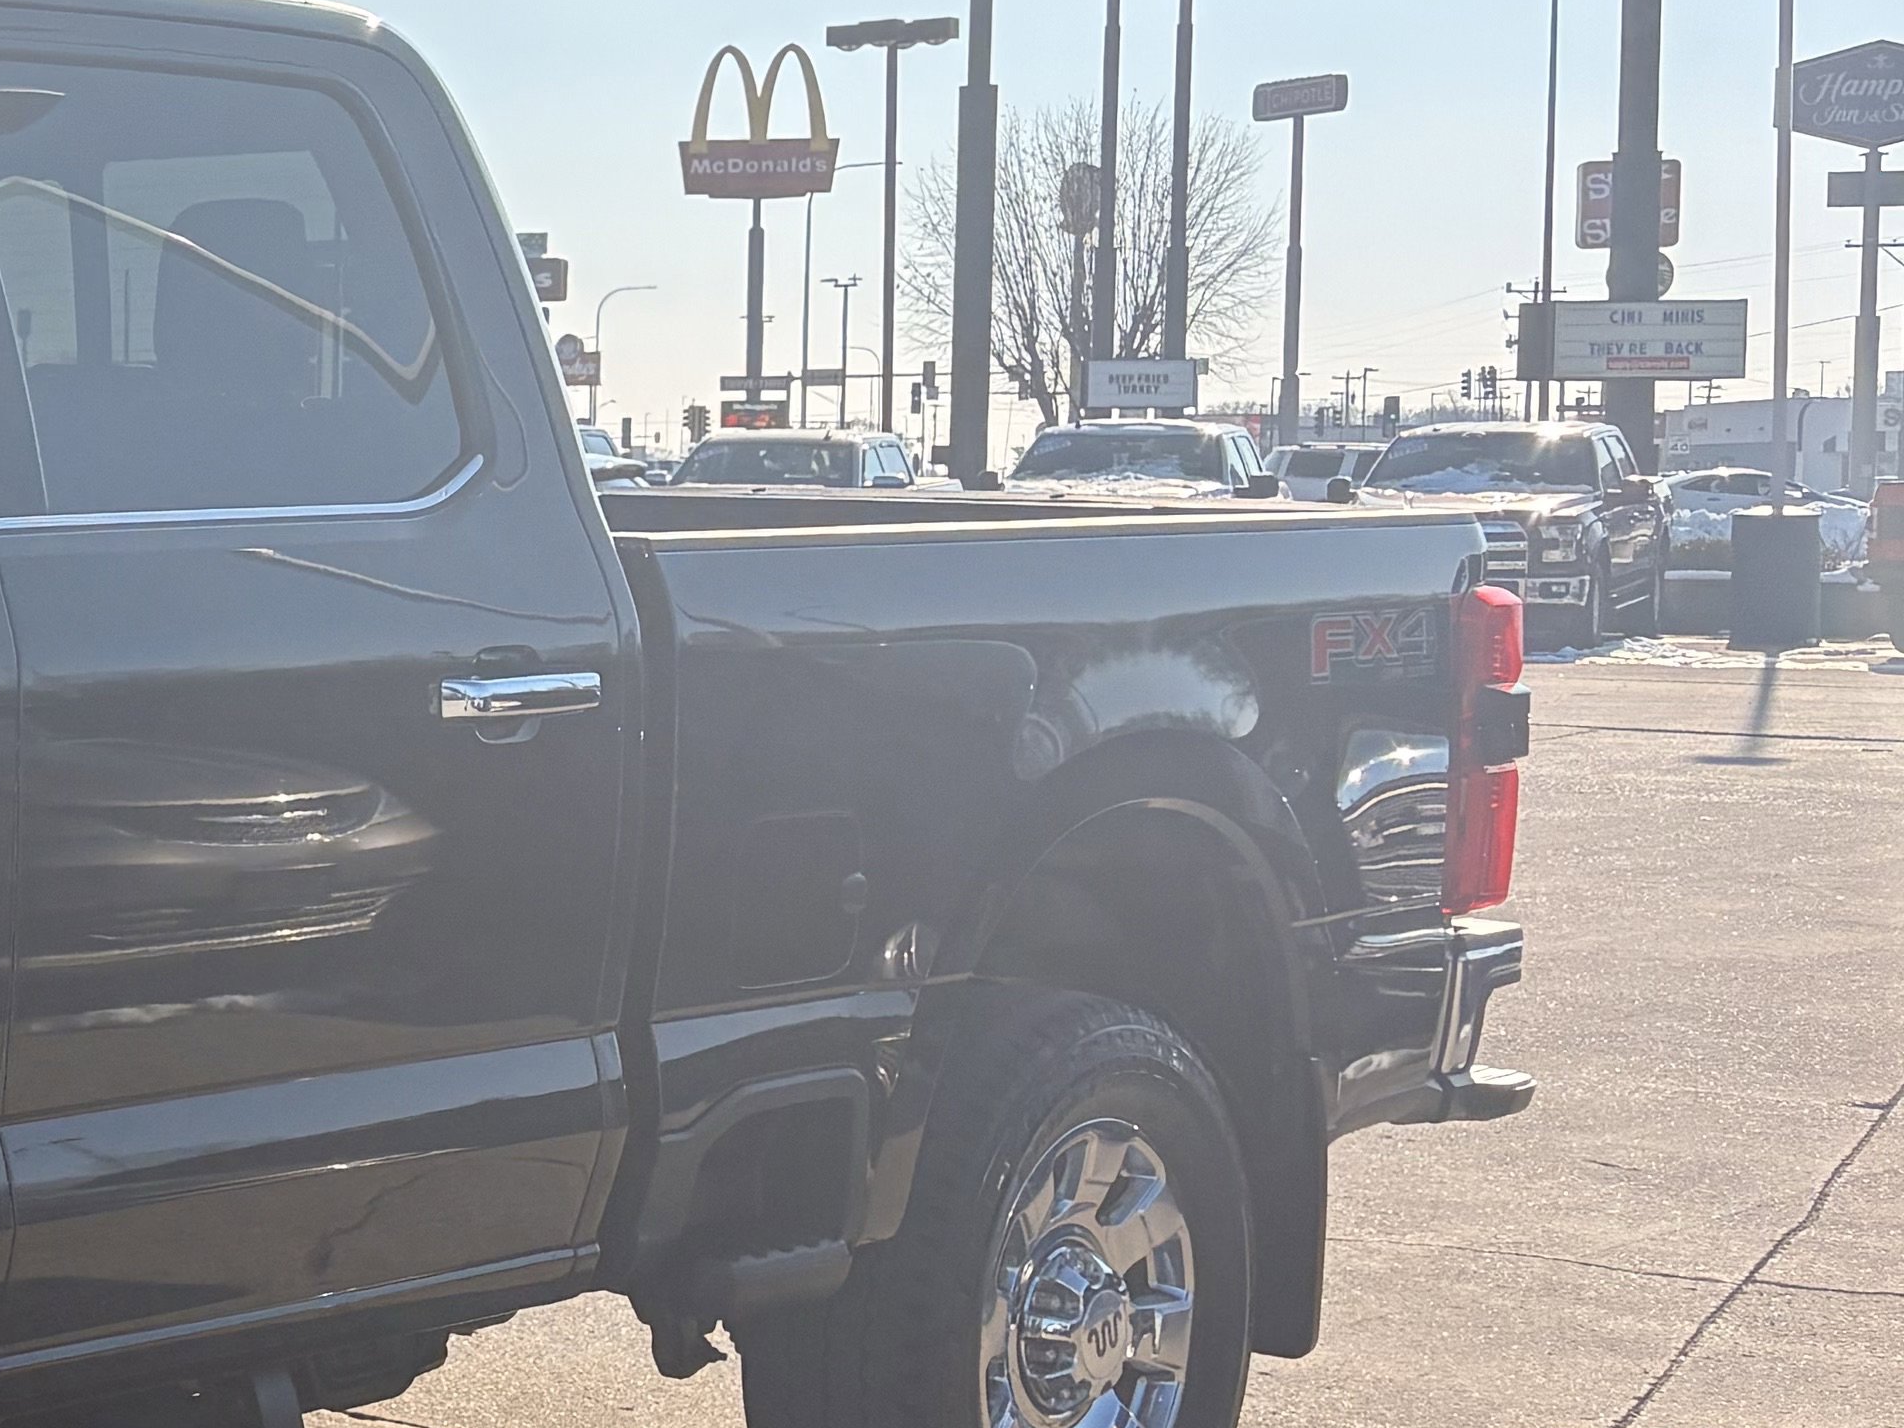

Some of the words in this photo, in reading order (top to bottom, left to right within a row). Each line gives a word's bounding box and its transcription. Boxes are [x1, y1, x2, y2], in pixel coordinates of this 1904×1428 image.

[690, 157, 828, 175] McDonald's
[1662, 309, 1705, 323] MINIS
[1664, 341, 1704, 355] BACK
[1311, 607, 1436, 685] FX4
